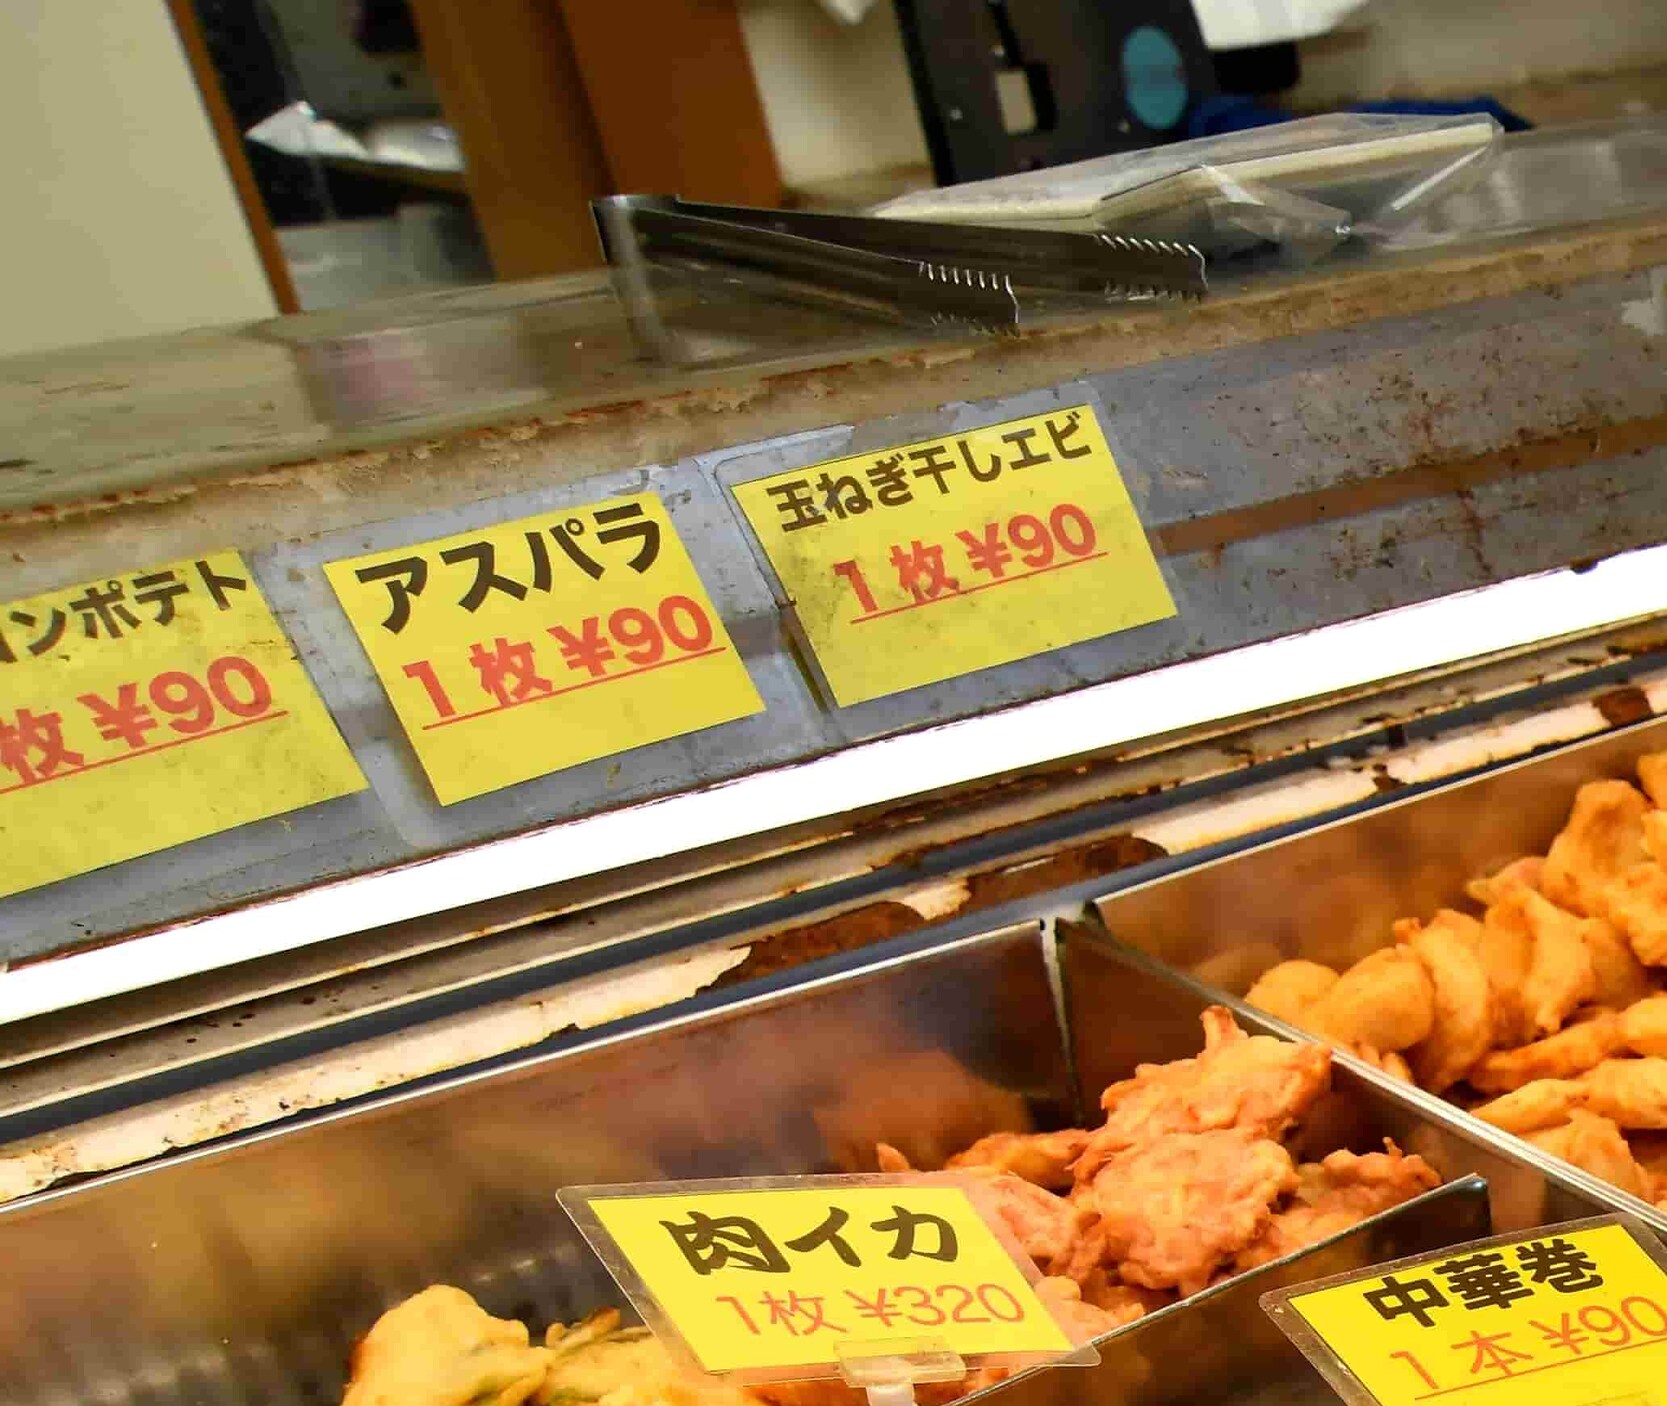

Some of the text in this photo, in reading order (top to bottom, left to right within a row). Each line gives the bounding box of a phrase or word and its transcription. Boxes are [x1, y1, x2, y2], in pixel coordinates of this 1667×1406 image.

[766, 411, 1092, 532] 玉ねぎ干しエビ
[355, 503, 660, 634] アスパラ
[955, 503, 1096, 578] ¥90
[547, 595, 713, 676] ¥90
[77, 656, 272, 749] ¥90
[658, 1205, 959, 1275] 肉イカ
[844, 1282, 1026, 1327] ¥320
[1363, 1238, 1604, 1328] 中華巻
